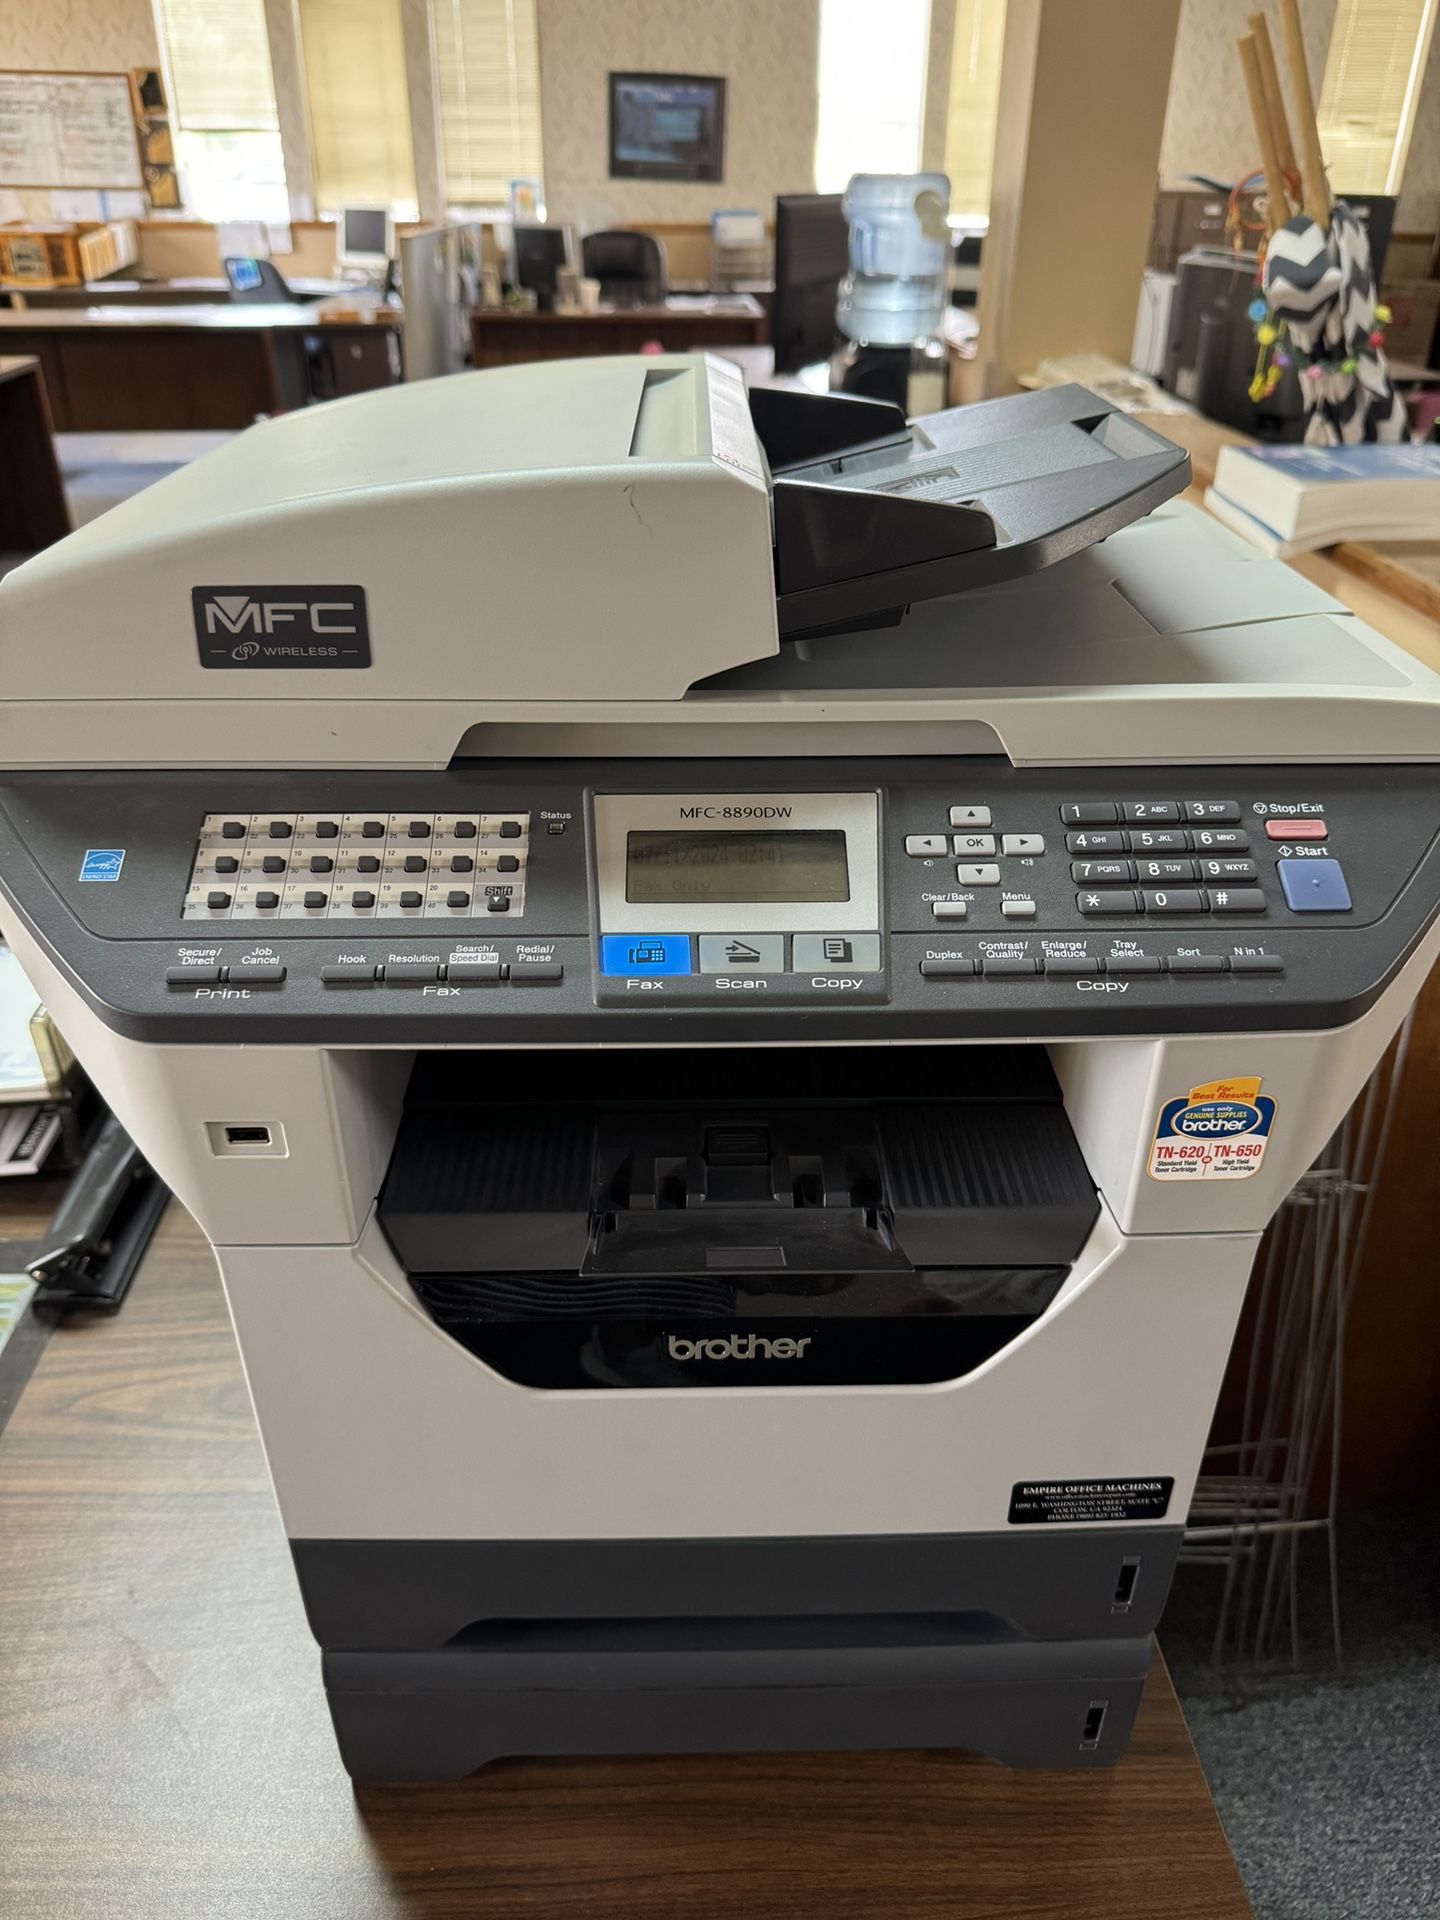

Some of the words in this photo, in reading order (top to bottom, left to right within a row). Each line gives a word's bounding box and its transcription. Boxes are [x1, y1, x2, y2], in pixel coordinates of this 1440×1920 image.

[205, 602, 357, 634] MFC
[264, 647, 338, 656] WIRELESS
[680, 806, 793, 819] MFC-8890DW
[1072, 805, 1080, 818] 1
[1135, 804, 1147, 816] 2
[1194, 803, 1205, 816] 3
[1269, 803, 1325, 814] Stop/Exit
[541, 811, 572, 820] Status
[967, 838, 984, 847] OK
[1076, 834, 1088, 847] 4
[1142, 833, 1153, 845] 5
[1201, 832, 1213, 844] 6
[1295, 846, 1328, 856] Start
[1081, 863, 1091, 876] 7
[1097, 865, 1121, 873] PQRS
[1148, 863, 1160, 876] 8
[1208, 862, 1220, 875] 9
[486, 887, 513, 896] Shift
[921, 892, 975, 901] Clear/Back
[1002, 892, 1031, 901] Menu
[1155, 893, 1167, 906] 0
[1216, 892, 1229, 905] #
[456, 944, 494, 953] Search/
[516, 945, 555, 954] Redial/
[978, 941, 1028, 950] Contrast/
[1041, 940, 1087, 951] Enlarge/
[1113, 940, 1137, 950] Tray
[178, 948, 223, 957] Secure/
[251, 947, 273, 956] Job
[926, 951, 963, 960] Duplex
[986, 950, 1024, 960] Quality
[1045, 949, 1087, 958] Reduce
[1111, 948, 1144, 957] Select
[1177, 948, 1201, 956] Sort
[1234, 947, 1243, 956] N
[1245, 947, 1254, 955] in
[1259, 947, 1264, 955] 1
[182, 956, 215, 965] Direct
[242, 956, 280, 965] Cancel
[338, 954, 366, 964] Hook
[388, 954, 440, 963] Resolution
[451, 953, 479, 963] Speed
[481, 953, 499, 962] Dial
[518, 954, 551, 962] Pause
[626, 979, 664, 990] Fax
[715, 978, 767, 989] Scan
[811, 977, 863, 990] Copy
[1076, 980, 1129, 992] Copy
[195, 988, 251, 999] Print
[423, 986, 461, 996] Fax
[1216, 1085, 1234, 1093] For
[1192, 1092, 1216, 1100] Best
[1218, 1091, 1255, 1099] Results
[1216, 1111, 1247, 1119] SUPPLIES
[1182, 1119, 1247, 1132] brother
[1156, 1146, 1206, 1159] TN-620
[1214, 1144, 1262, 1157] TN-650
[1171, 1166, 1197, 1174] Cartridge
[668, 1334, 811, 1361] brother
[1023, 1486, 1063, 1495] EMPIRE
[1065, 1484, 1103, 1493] OFFICE
[1105, 1482, 1162, 1492] MACHINES
[1041, 1500, 1095, 1509] WASHINGTON
[1048, 1513, 1075, 1521] PHONE
